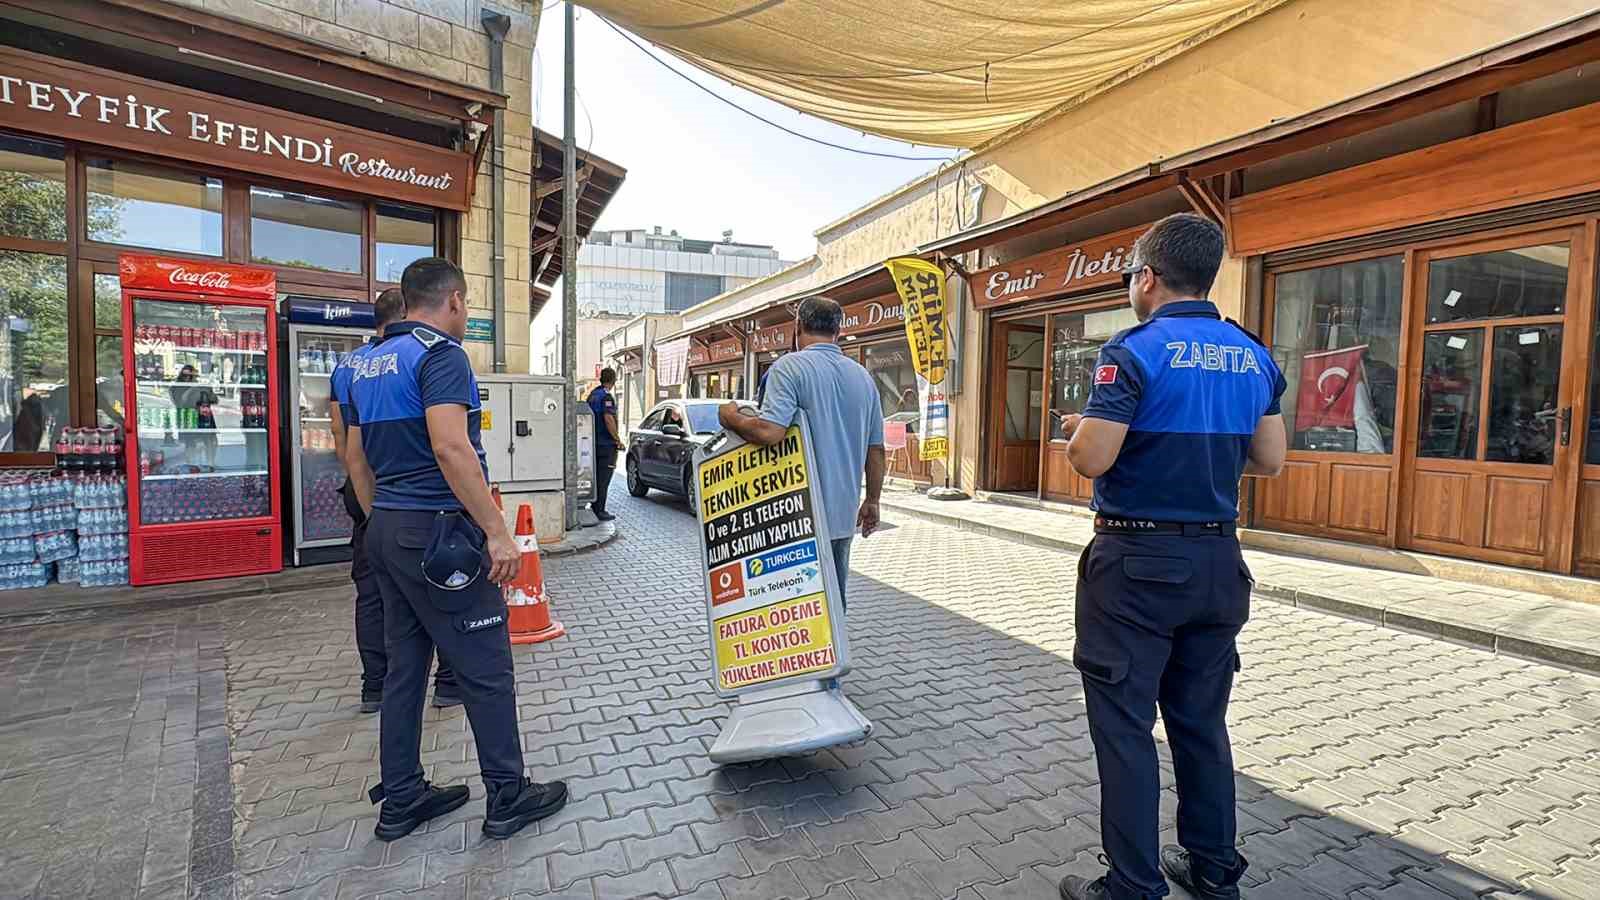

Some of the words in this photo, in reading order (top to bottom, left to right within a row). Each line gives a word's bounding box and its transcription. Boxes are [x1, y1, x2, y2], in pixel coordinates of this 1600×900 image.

[0, 75, 173, 136] TEYFİK
[187, 111, 334, 167] EFENDİ
[338, 151, 455, 190] Restaurant
[984, 269, 1045, 301] Emir
[839, 312, 860, 329] alon
[1166, 341, 1261, 375] ZABITA
[703, 458, 734, 489] EMİR
[703, 481, 751, 517] TEKNİK
[753, 461, 805, 498] SERVİS
[717, 524, 729, 539] ve
[729, 514, 742, 534] 2.
[743, 509, 755, 529] EL
[755, 494, 805, 524] TELEFON
[708, 542, 731, 566] ALIM
[731, 529, 767, 557] SATIMI
[766, 517, 814, 545] YAPILIR
[765, 546, 815, 569] TURKCELL
[748, 585, 767, 598] Türk
[767, 575, 804, 593] Telekom
[469, 615, 503, 628] ZABITA
[719, 614, 767, 641] FATURA
[769, 599, 823, 628] ÖDEME
[751, 626, 812, 656] KONTÖR
[721, 660, 777, 686] YÜKLEME
[779, 643, 837, 674] MERKEZİ
